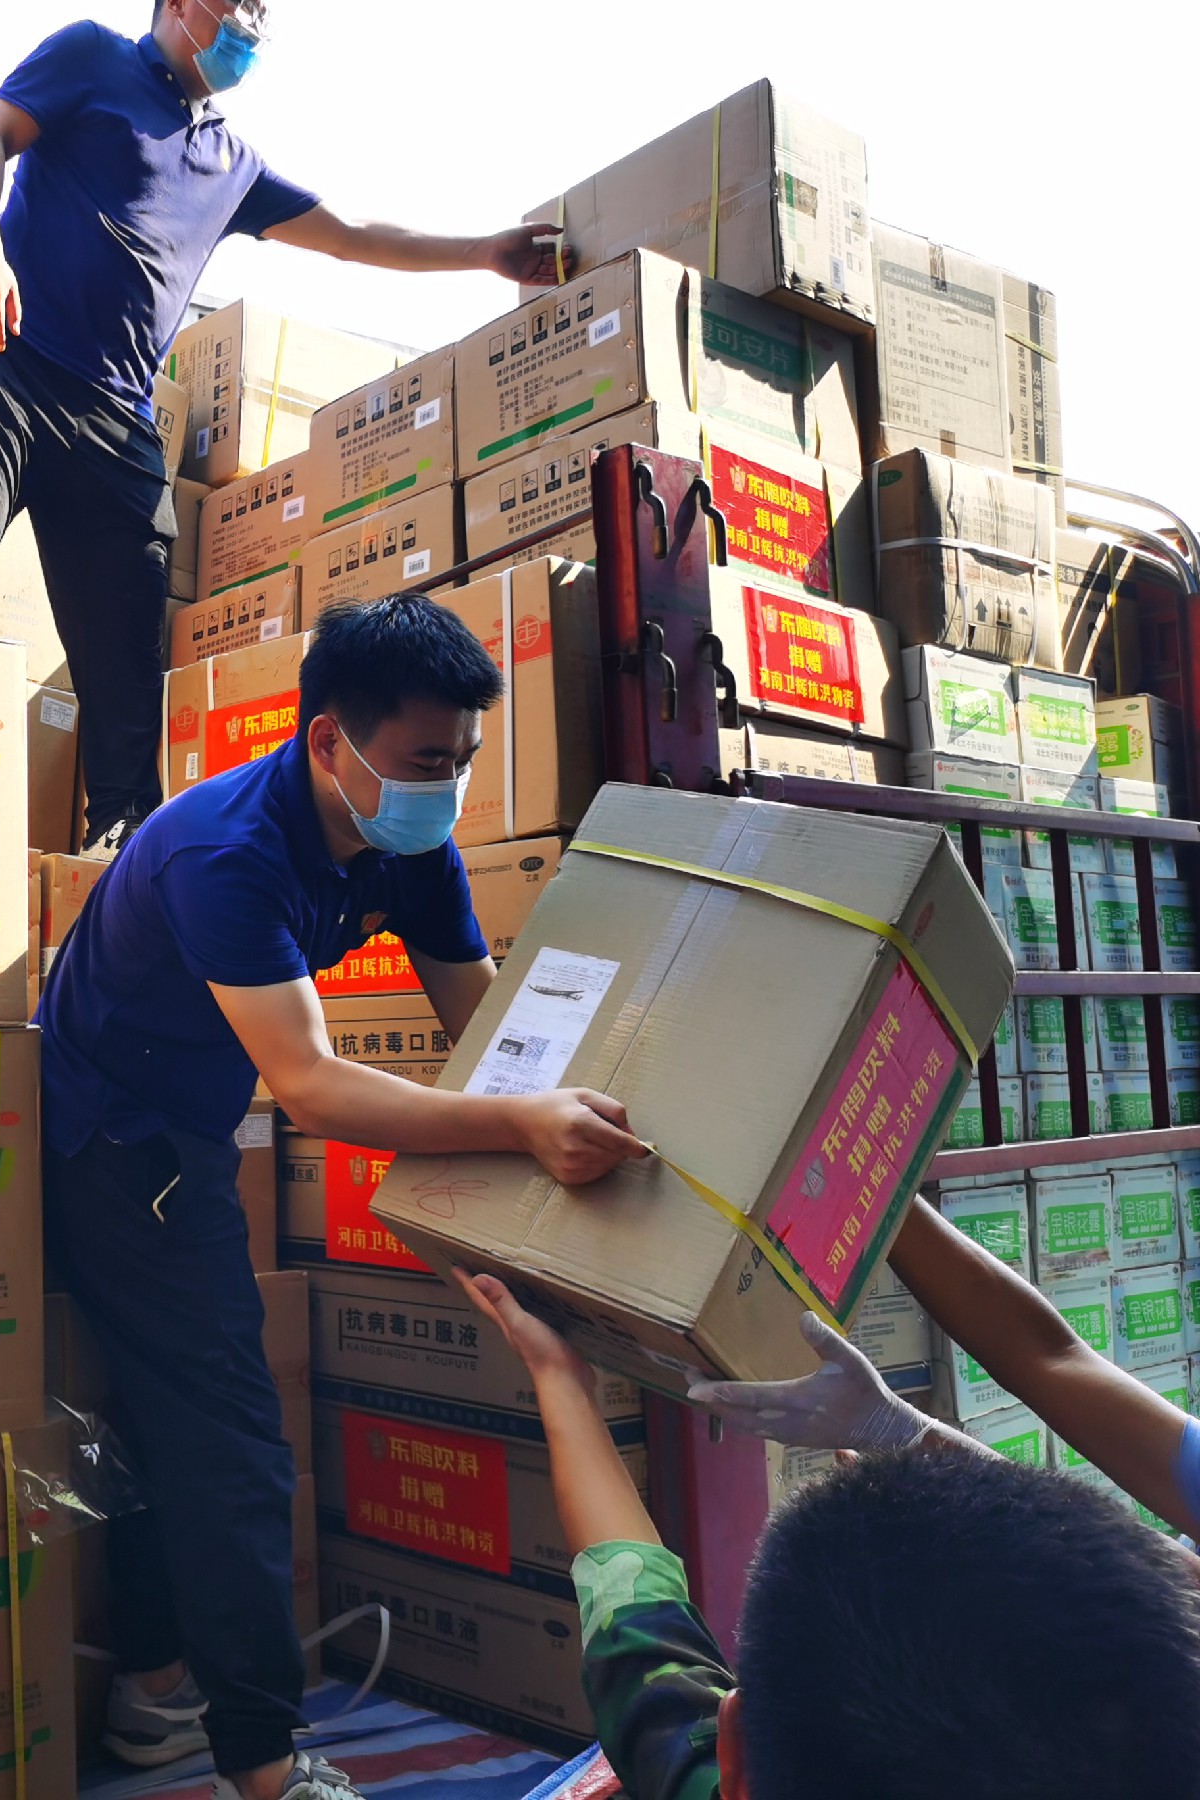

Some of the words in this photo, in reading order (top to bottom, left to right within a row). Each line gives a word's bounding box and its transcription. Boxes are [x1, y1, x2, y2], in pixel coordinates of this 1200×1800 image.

[747, 473, 811, 517] 东鹏饮料
[754, 507, 789, 538] 捐赠
[779, 609, 841, 648] 东鹏饮料
[788, 645, 823, 674] 捐赠
[759, 667, 856, 709] 河南卫辉抗洪物资
[820, 1010, 901, 1164] 东鹏饮料
[846, 1095, 893, 1177] 捐赠
[825, 1046, 946, 1274] 河南卫辉抗洪物资
[337, 1226, 415, 1256] 河南卫辉
[345, 1307, 479, 1349] 抗病毒口服液
[425, 1354, 479, 1372] KOUFUYE
[389, 1436, 480, 1479] 东鹏饮料
[400, 1475, 445, 1509] 捐赠
[357, 1497, 496, 1556] 河南卫辉抗洪物资
